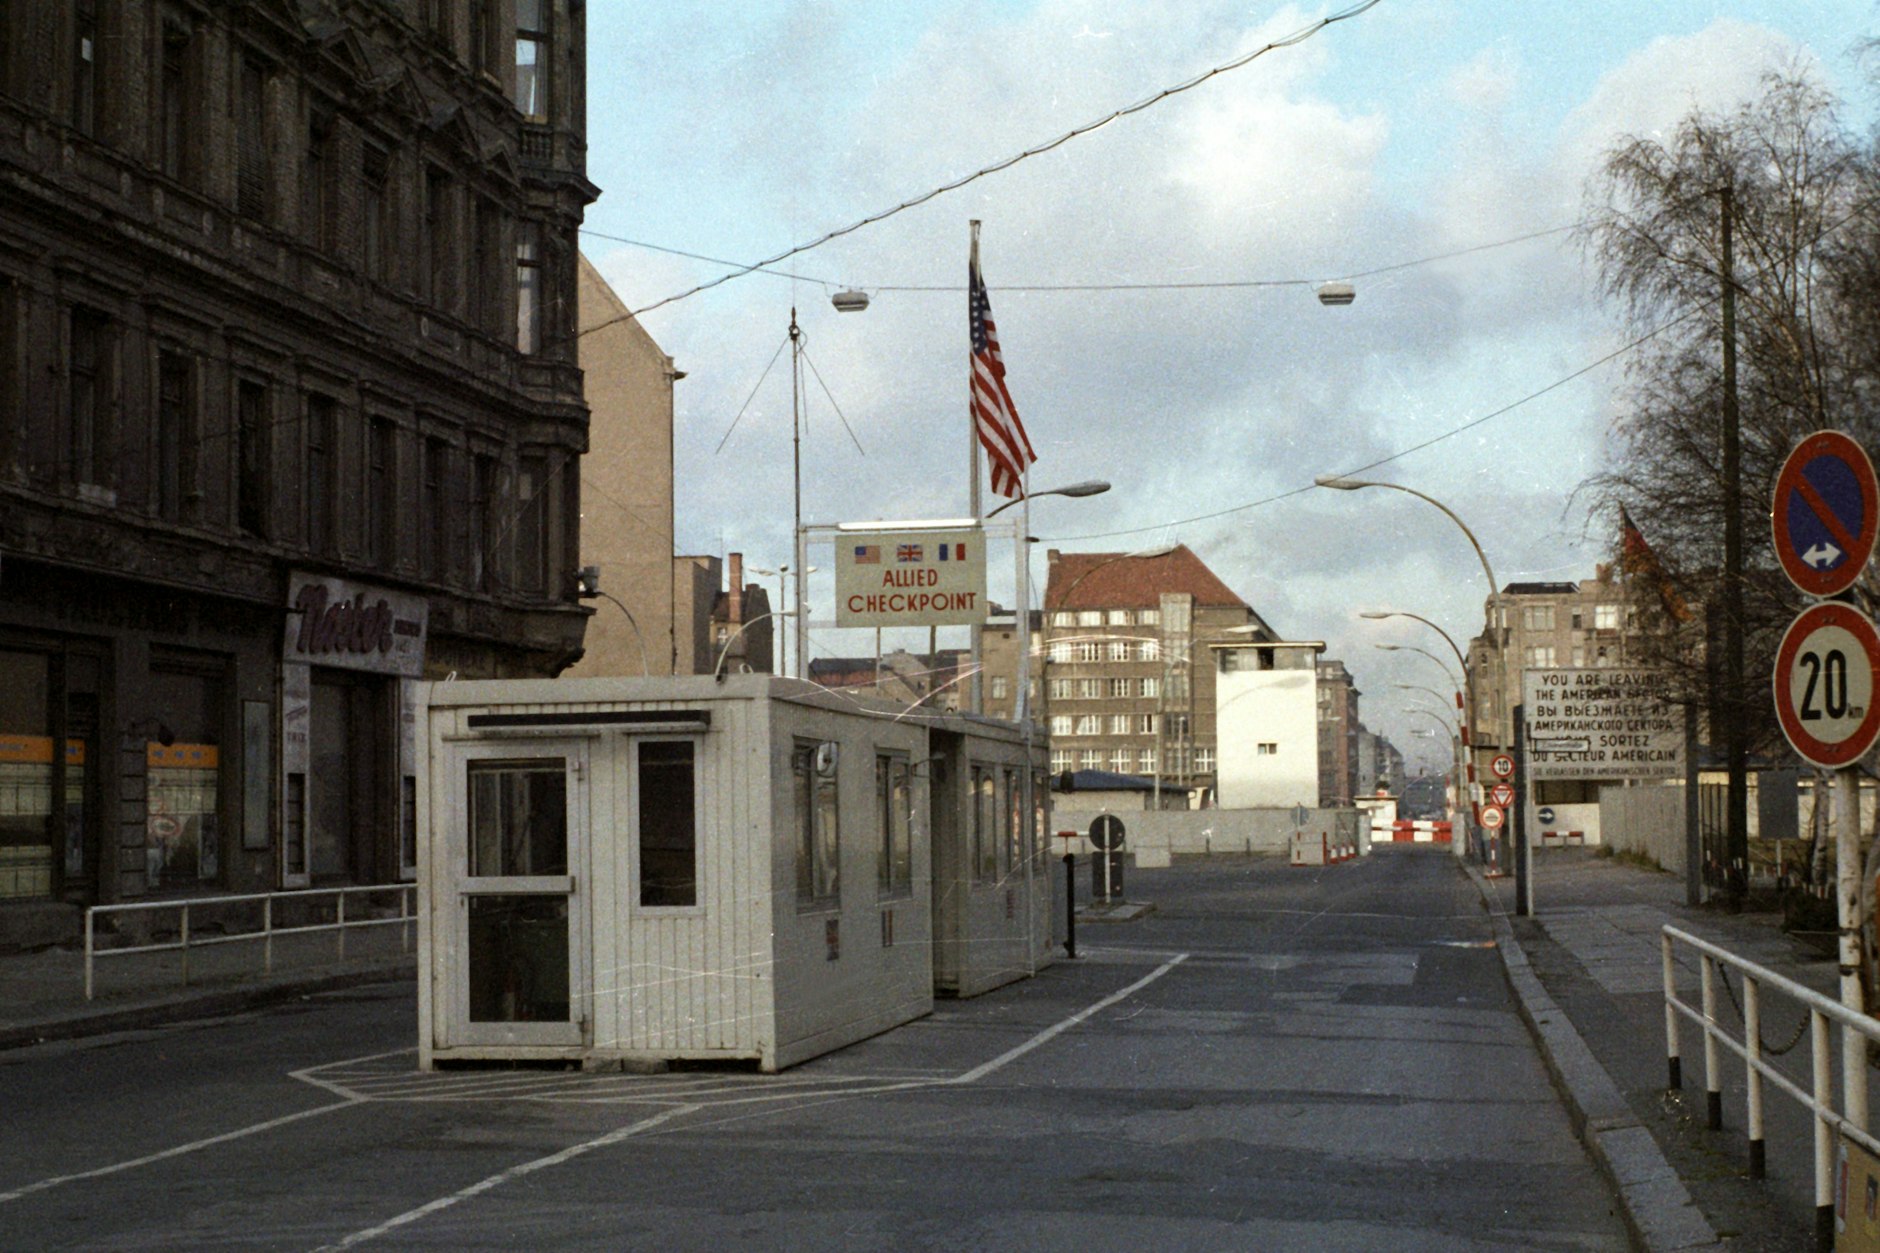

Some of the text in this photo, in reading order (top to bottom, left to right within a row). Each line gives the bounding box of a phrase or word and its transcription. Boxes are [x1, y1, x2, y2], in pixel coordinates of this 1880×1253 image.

[882, 569, 938, 588] ALLIED
[848, 592, 976, 613] CHECKPOINT
[1542, 674, 1568, 686] YOU
[1575, 674, 1600, 686] ARE
[1800, 649, 1864, 721] 20 km
[1536, 689, 1555, 701] THE
[1561, 689, 1620, 701] AMERICAN
[1537, 705, 1557, 717] ВЫ
[1564, 704, 1644, 717] ВЫЕЗЖАЕТЕ
[1535, 719, 1674, 732] АМЕРИКАНСКОГО СЕКТОРА
[1600, 735, 1650, 747] SORTEZ
[1533, 750, 1548, 762] DU
[1497, 760, 1509, 773] 10
